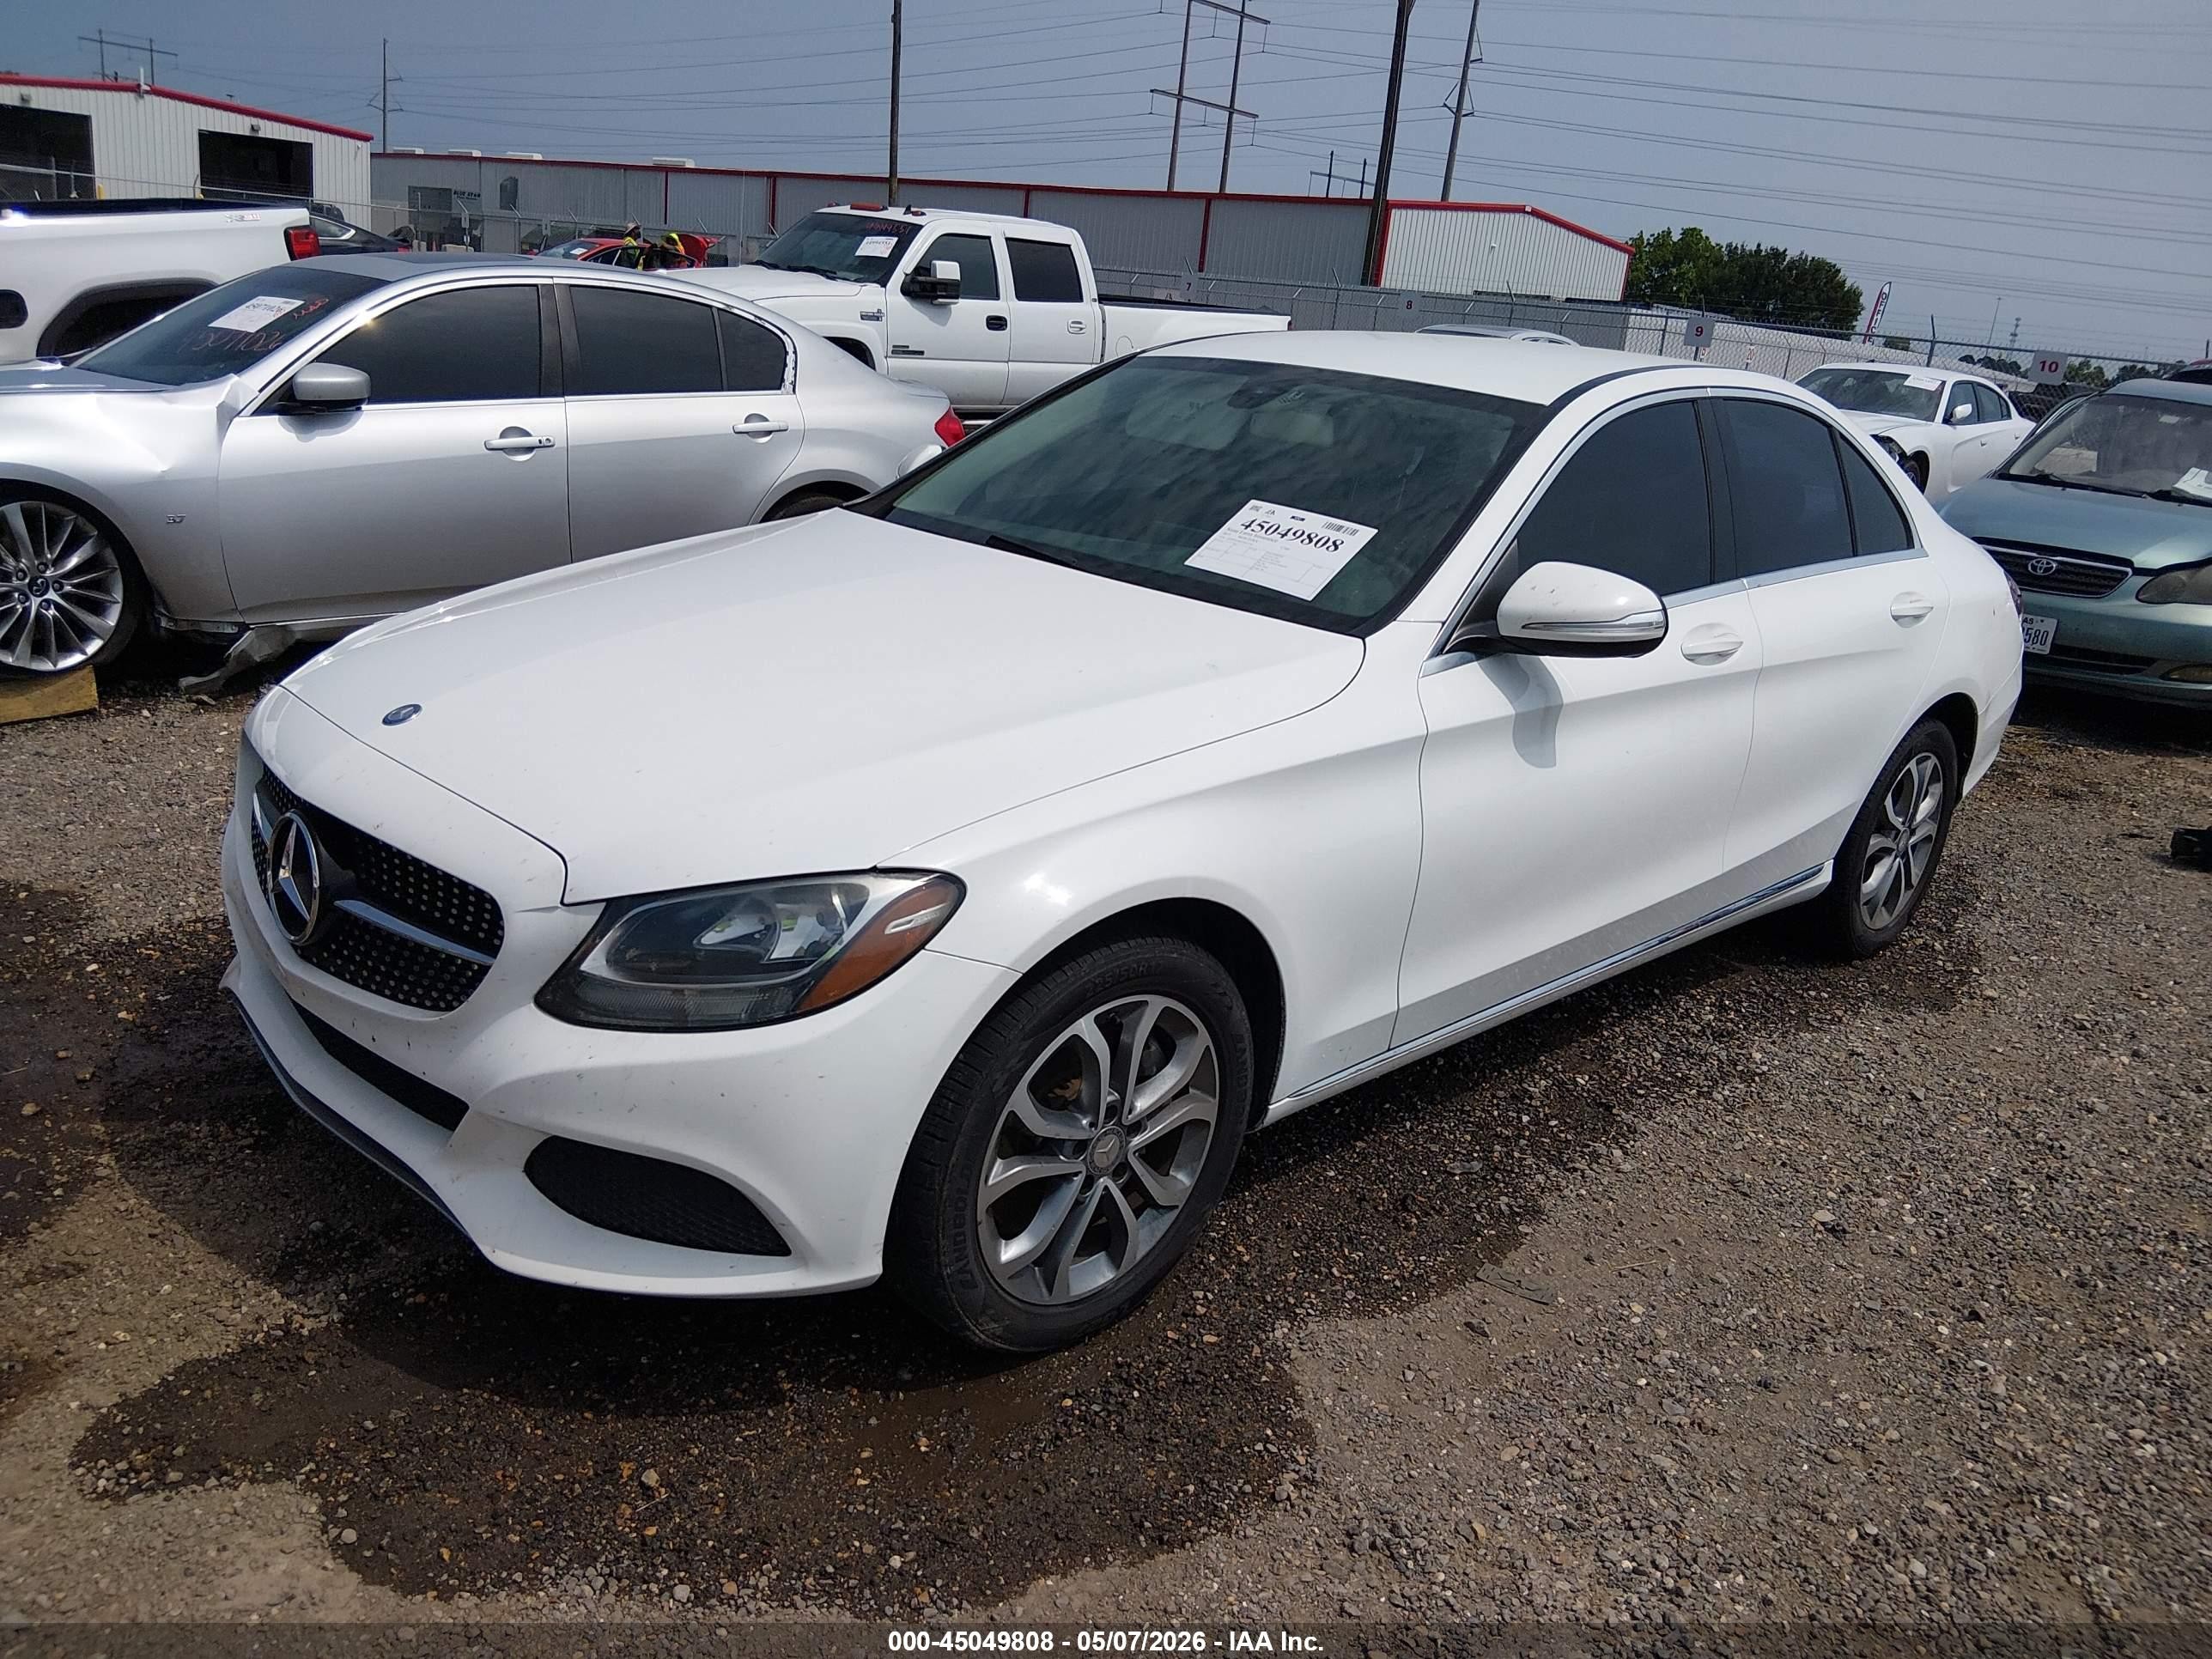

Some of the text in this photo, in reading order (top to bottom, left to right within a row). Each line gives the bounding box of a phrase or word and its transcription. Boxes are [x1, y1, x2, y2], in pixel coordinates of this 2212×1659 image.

[1186, 282, 1192, 292] 7
[1406, 300, 1413, 311] 8
[1868, 292, 1887, 343] OFFICE
[1694, 325, 1705, 337] 9
[2039, 359, 2059, 374] 10
[1241, 518, 1345, 553] 45049808
